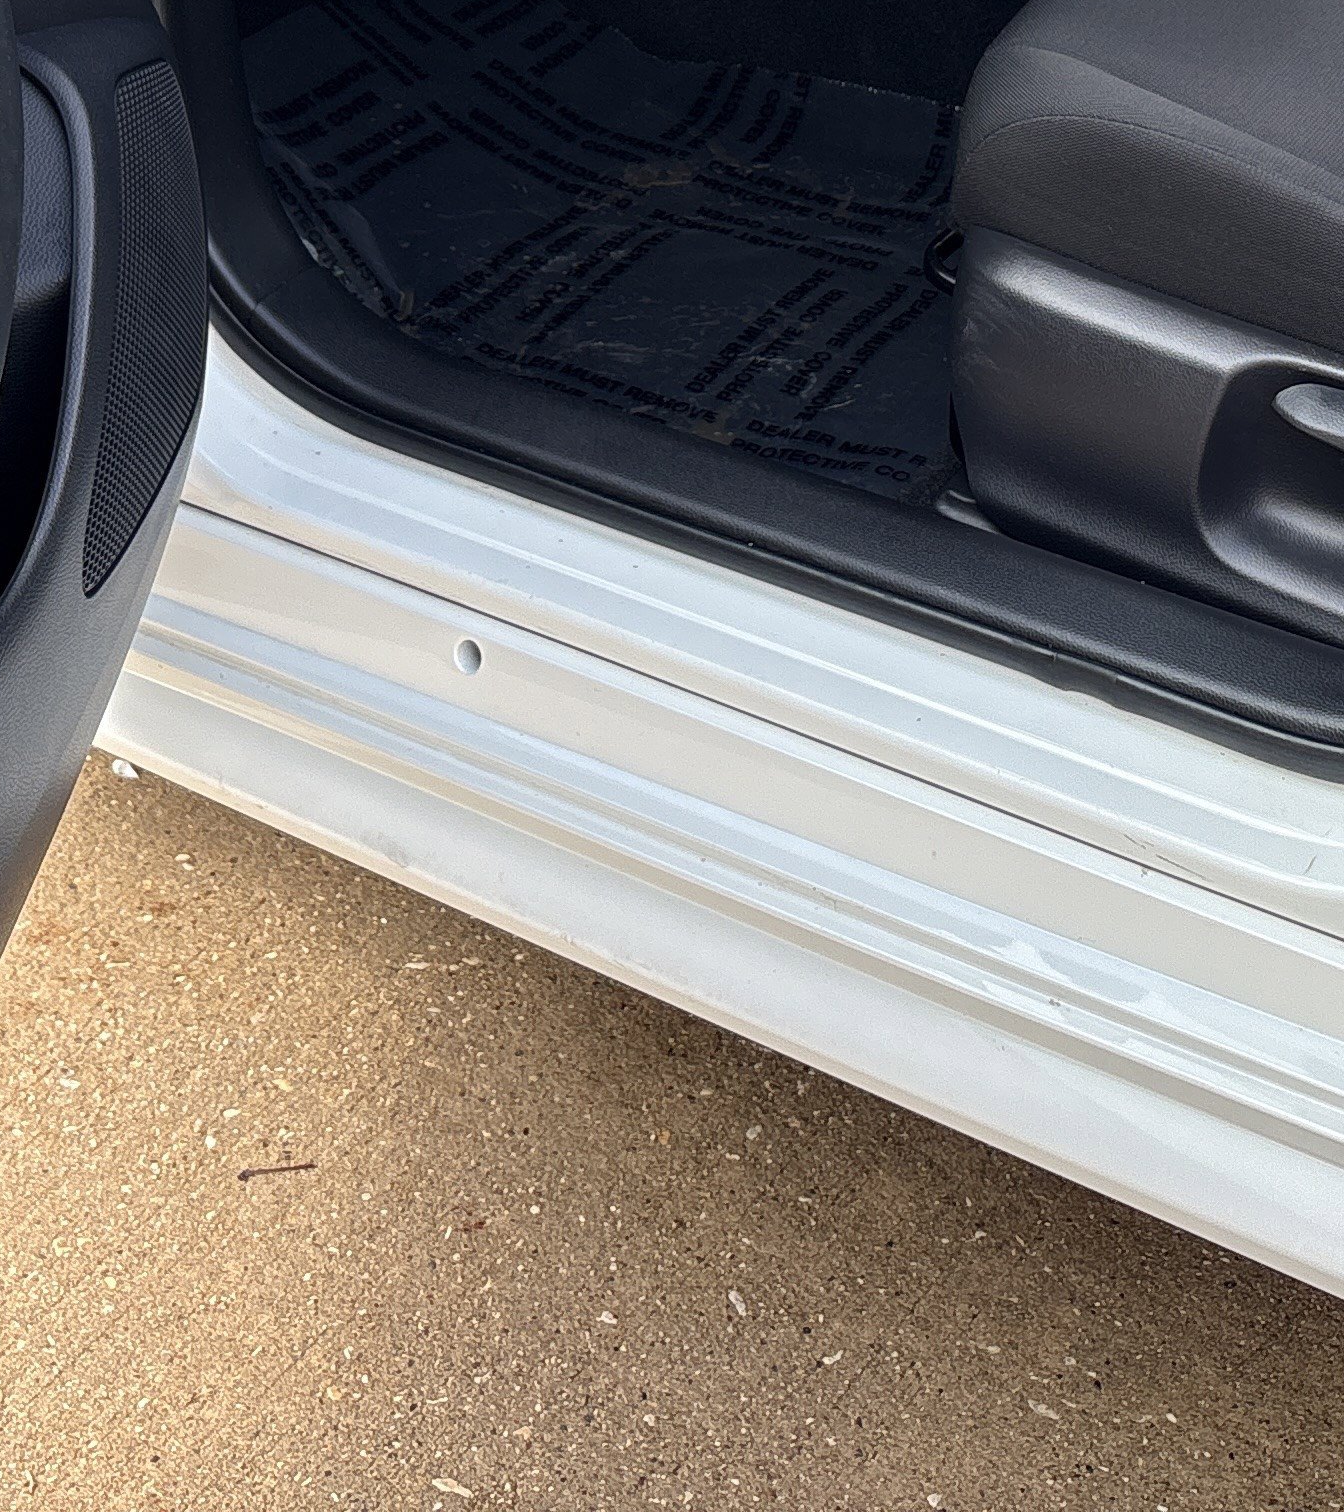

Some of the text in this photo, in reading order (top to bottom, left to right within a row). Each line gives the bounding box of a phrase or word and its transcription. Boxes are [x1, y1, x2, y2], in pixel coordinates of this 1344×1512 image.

[470, 71, 577, 142] PROTECTIVE
[488, 59, 556, 107] DEALER
[557, 106, 610, 136] MUST
[739, 89, 780, 143] COVER
[280, 162, 340, 234] DEALER
[786, 186, 839, 207] MUST
[846, 202, 931, 224] REMOVE
[797, 246, 878, 272] DEALER
[685, 269, 835, 393] DEALER MUST REMOVE
[779, 283, 908, 396] PROTECTIVE COVER
[799, 290, 848, 322] COVER
[475, 343, 559, 370] DEALER
[559, 364, 625, 393] MUST
[623, 386, 717, 423] REMOVE
[794, 290, 938, 421] DEALER MUST REMOVE
[730, 434, 870, 470] PROTECTIVE
[746, 420, 908, 458] DEALER MUST
